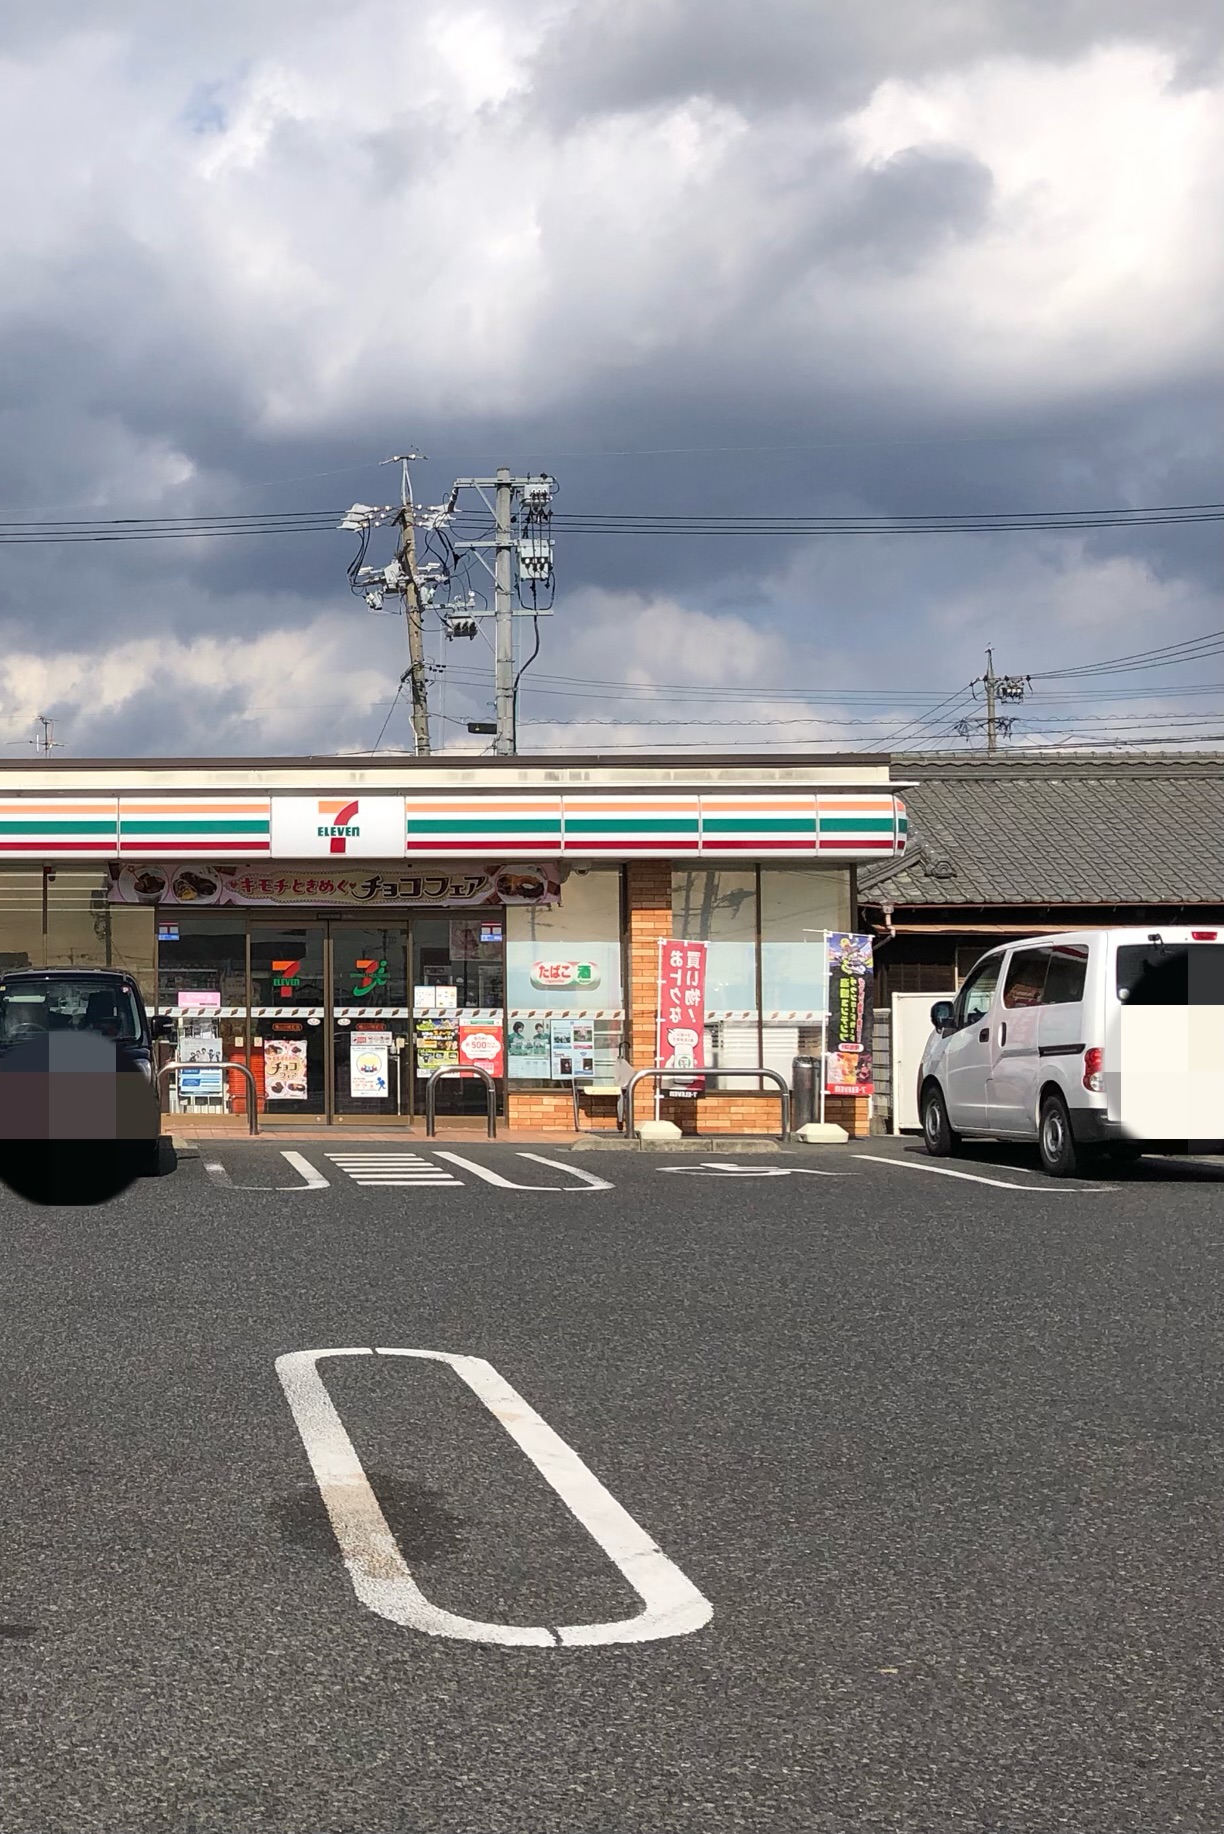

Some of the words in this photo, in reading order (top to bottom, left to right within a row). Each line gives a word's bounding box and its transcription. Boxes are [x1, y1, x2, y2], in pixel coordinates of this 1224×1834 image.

[241, 877, 348, 894] キモチときめく
[352, 875, 487, 899] チョコフェア
[538, 964, 571, 979] たばこ
[577, 965, 591, 979] 酒
[266, 1061, 298, 1076] チョコ
